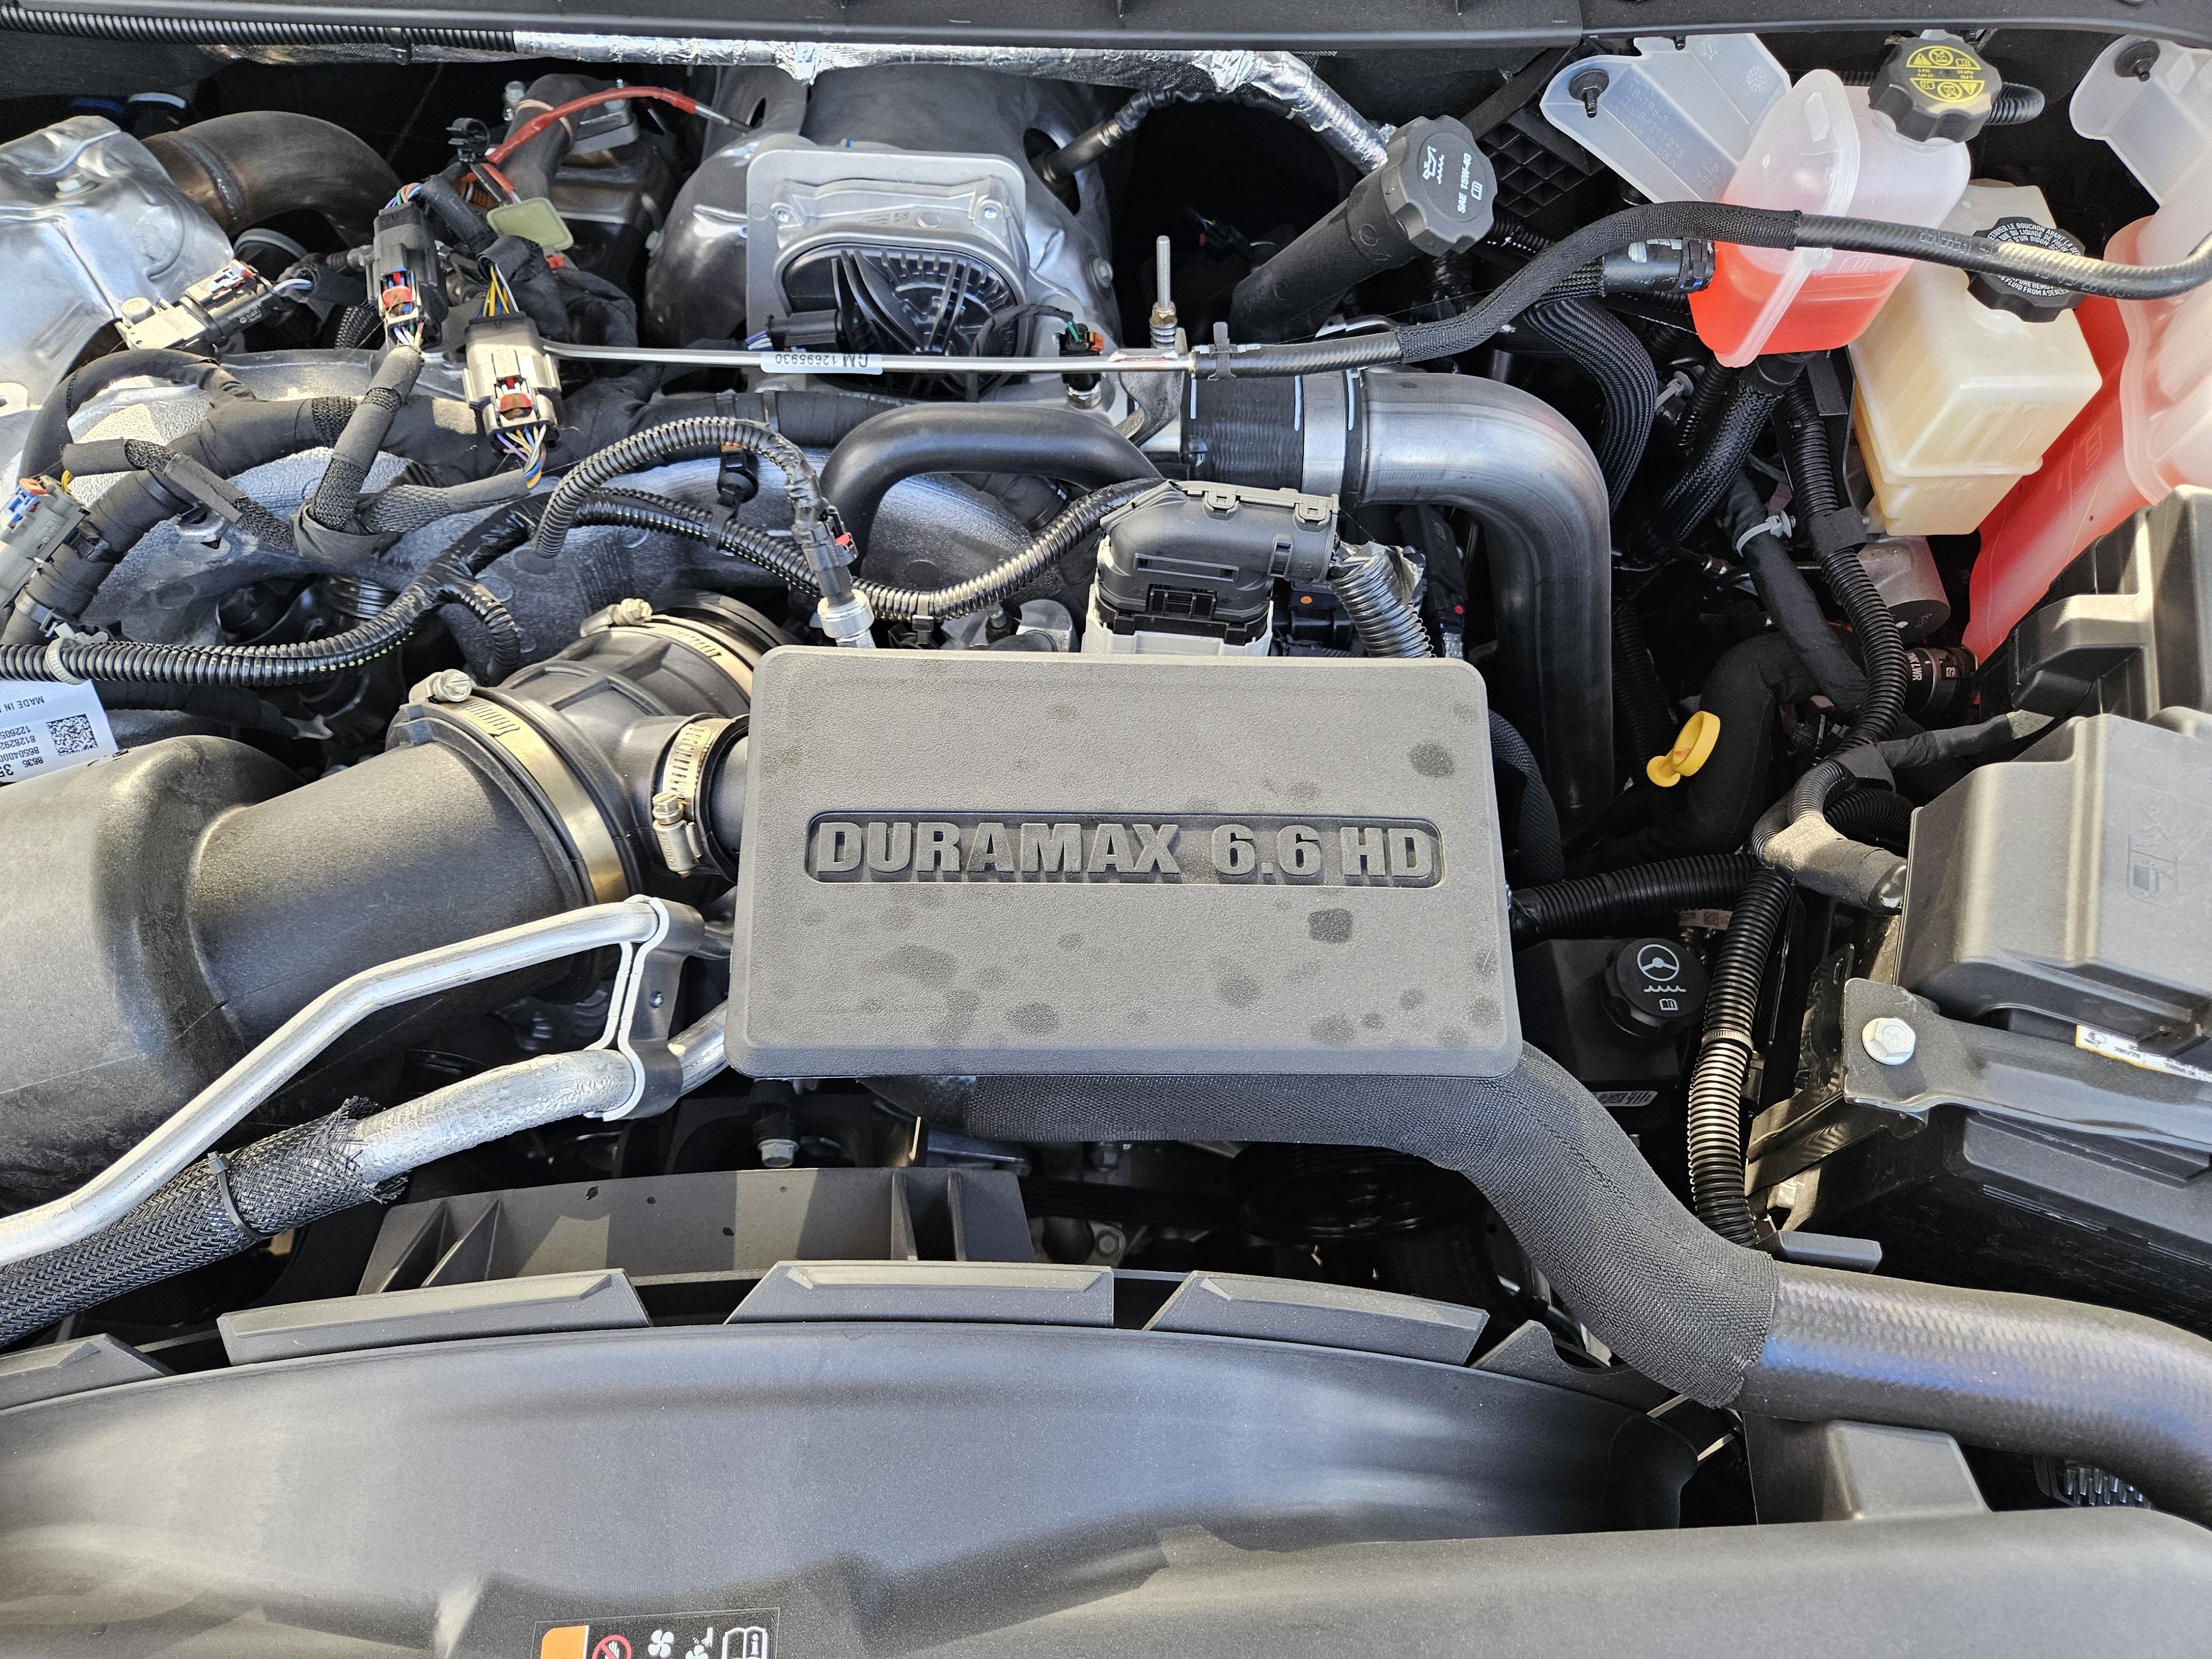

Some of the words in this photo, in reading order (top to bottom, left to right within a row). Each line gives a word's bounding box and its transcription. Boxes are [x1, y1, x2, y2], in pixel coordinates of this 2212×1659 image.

[1656, 145, 1677, 169] USA
[1460, 153, 1472, 190] 15W-40
[1457, 191, 1467, 214] SAE
[1987, 225, 2008, 239] ETTOYER
[2016, 223, 2045, 232] BOUCHON
[2046, 229, 2066, 241] AVANT
[2019, 229, 2042, 238] LIQUIDE
[2052, 239, 2069, 252] FREIN
[2030, 236, 2049, 246] BIDON
[2005, 278, 2022, 290] FLUID
[2023, 287, 2042, 296] FROM
[775, 354, 837, 366] 12695930
[843, 354, 868, 368] GM
[1911, 664, 1922, 681] LWR
[4, 702, 15, 712] IN
[15, 696, 44, 709] MADE
[22, 757, 43, 768] 8635
[816, 821, 1181, 876] DURAMAX
[1211, 824, 1321, 878] 6.6
[1340, 826, 1432, 879] HD
